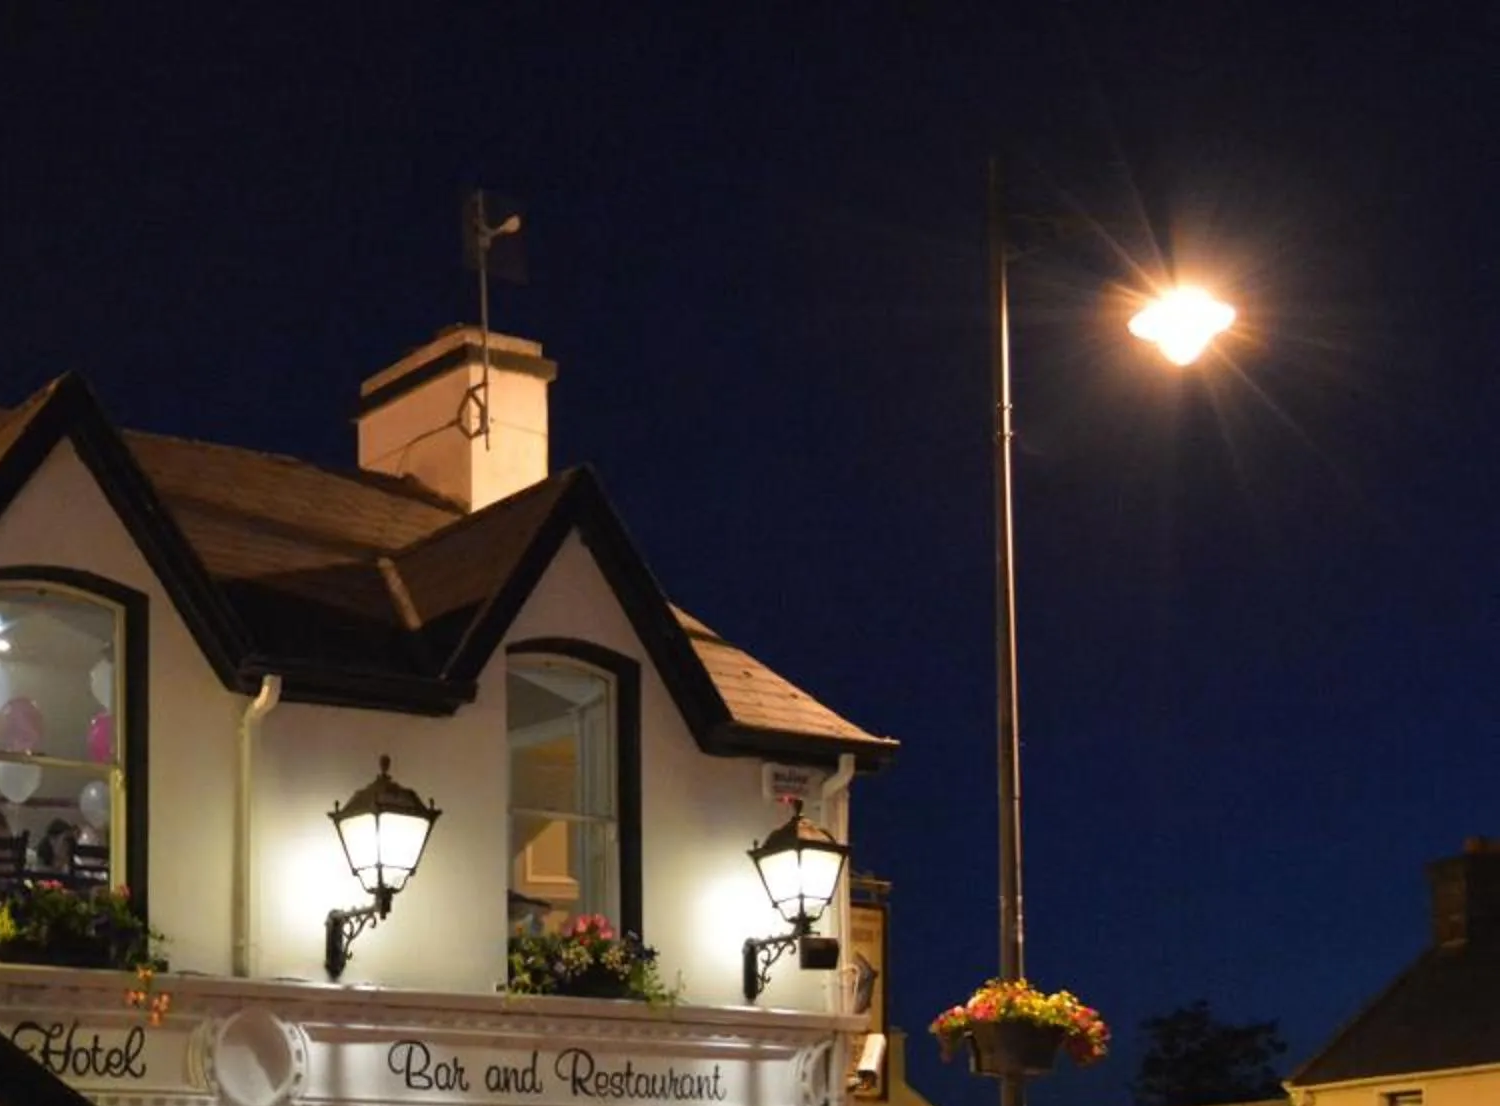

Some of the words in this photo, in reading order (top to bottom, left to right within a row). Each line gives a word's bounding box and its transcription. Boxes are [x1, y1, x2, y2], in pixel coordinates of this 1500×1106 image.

[11, 1018, 147, 1078] Hotel
[388, 1040, 469, 1092] Bar
[485, 1049, 542, 1094] and
[555, 1047, 727, 1101] Restaurant
